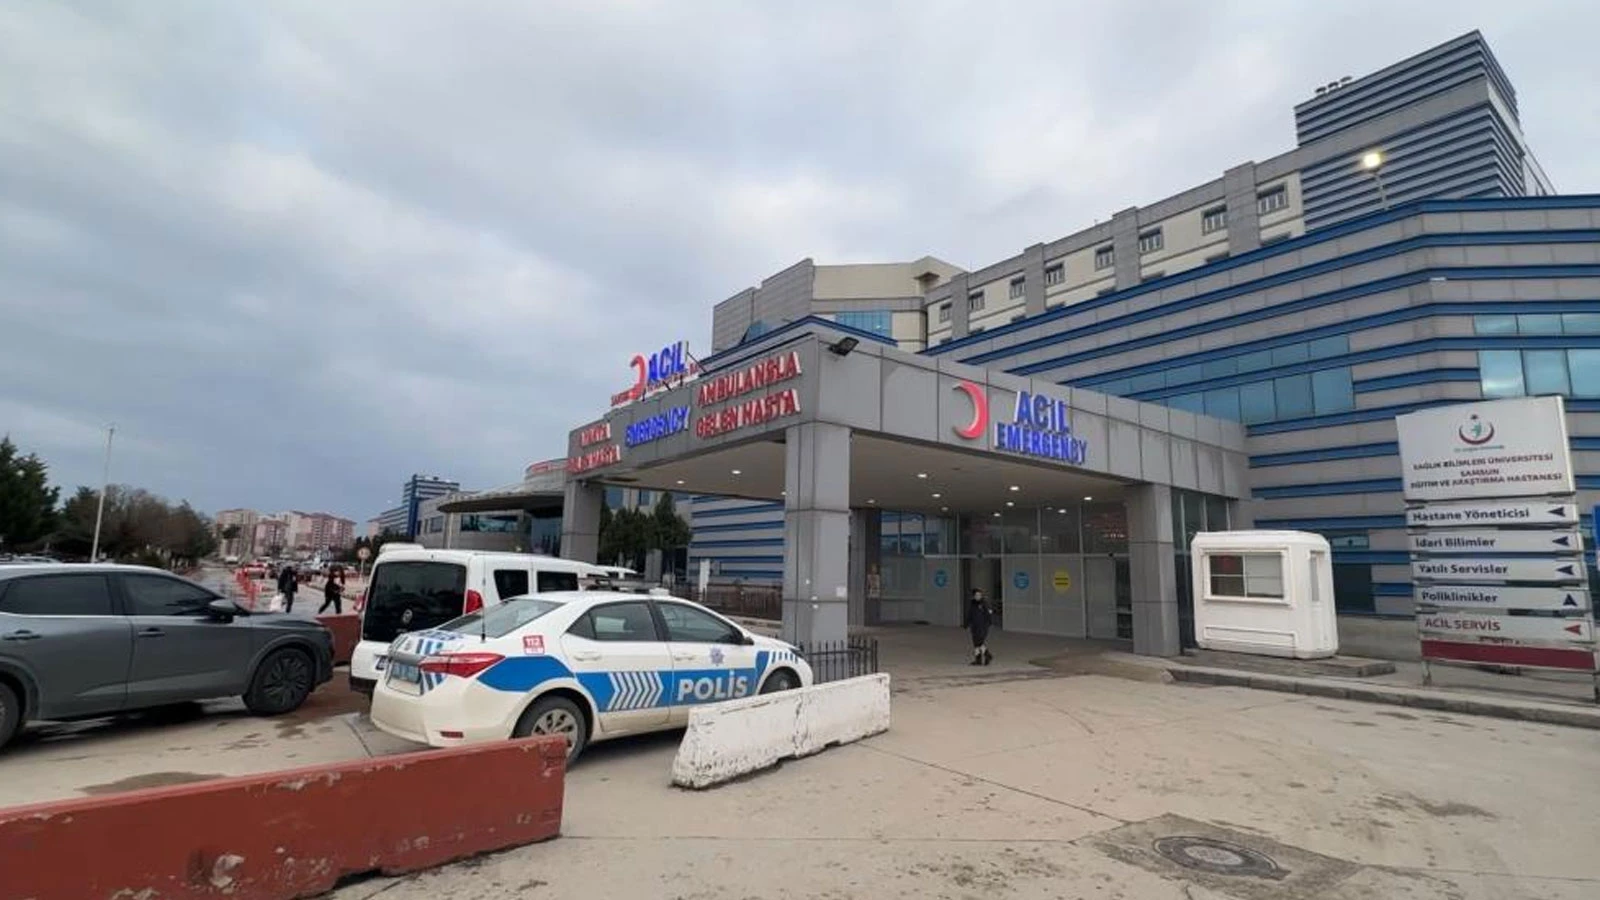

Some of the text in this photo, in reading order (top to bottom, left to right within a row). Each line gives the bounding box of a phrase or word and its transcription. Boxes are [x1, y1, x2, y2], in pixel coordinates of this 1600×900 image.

[697, 351, 802, 407] AMBULANSLA
[744, 388, 802, 428] HASTA
[625, 404, 691, 448] EMERGENCY
[994, 422, 1087, 465] EMERGENCY
[1460, 468, 1500, 477] SAMSUN
[1440, 478, 1450, 487] VE
[1413, 507, 1530, 521] Hastane Yöneticisi
[1445, 536, 1496, 548] Bilimler
[1420, 563, 1508, 575] Yatılı Servisler
[1422, 591, 1498, 602] Poliklinikler
[1454, 619, 1501, 631] SERVİS
[677, 670, 748, 701] POLİS
